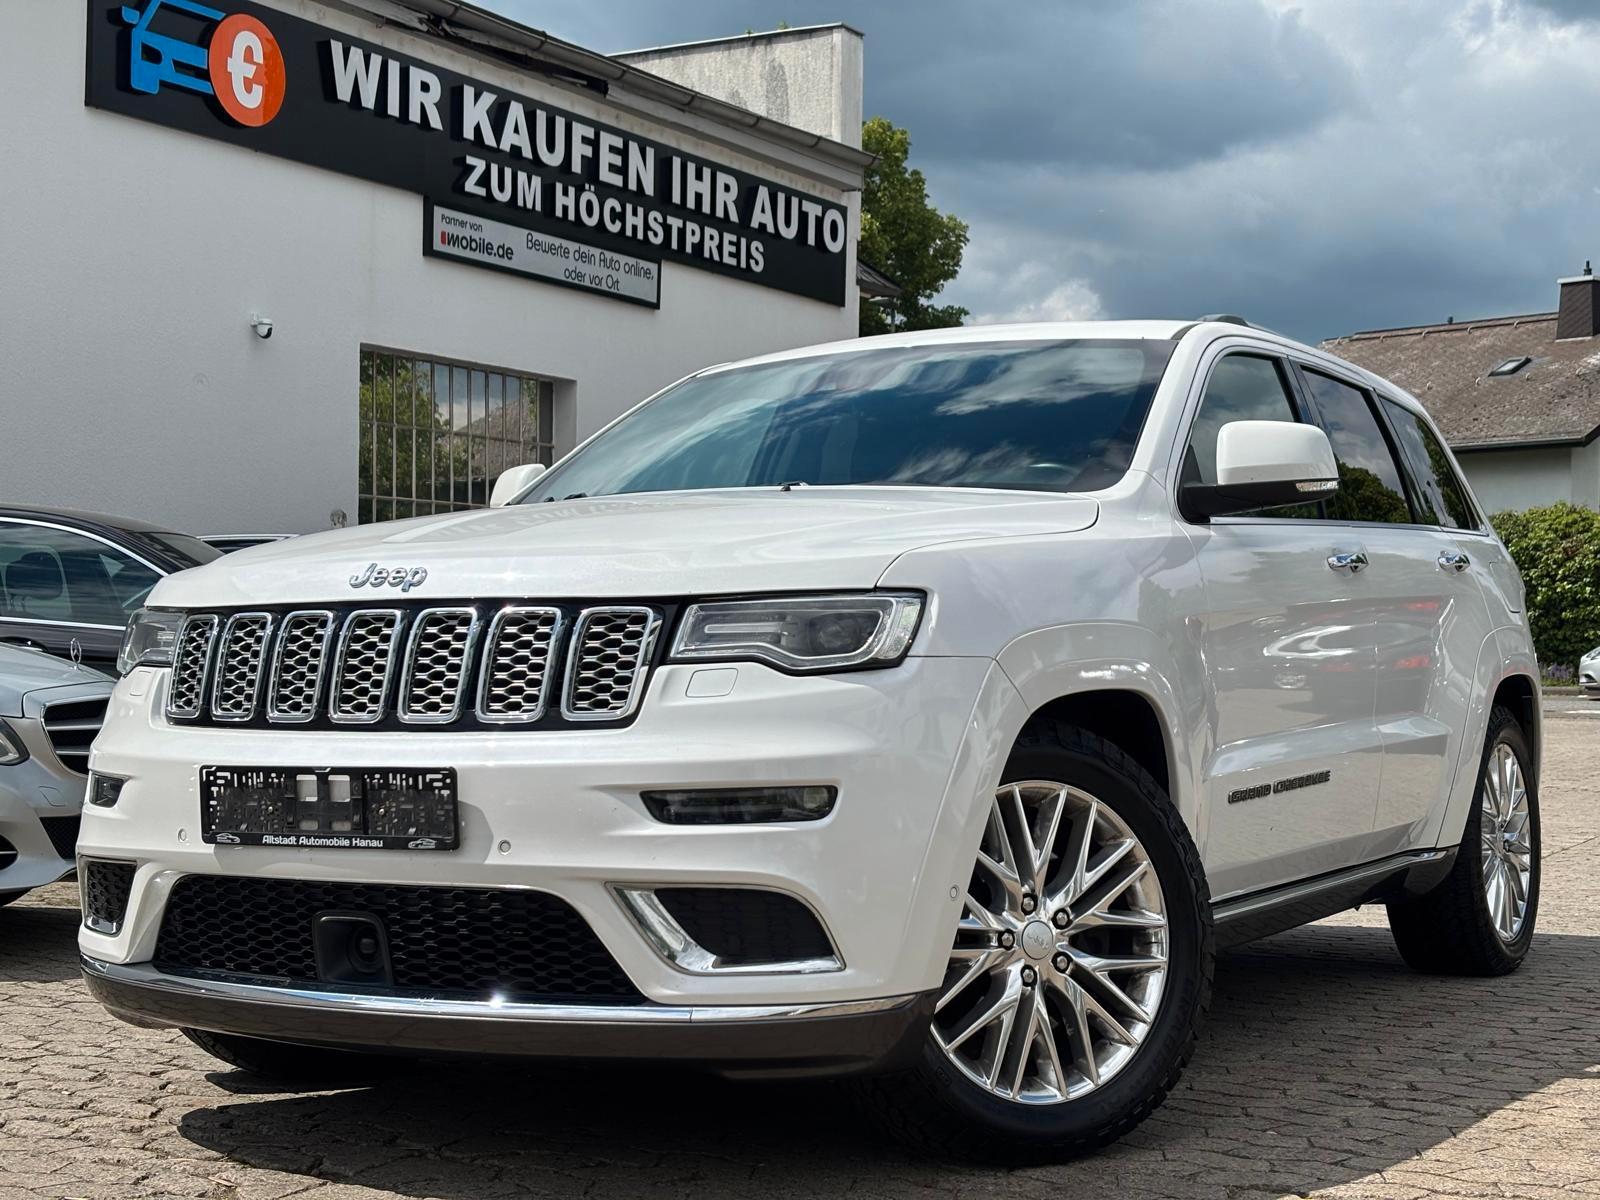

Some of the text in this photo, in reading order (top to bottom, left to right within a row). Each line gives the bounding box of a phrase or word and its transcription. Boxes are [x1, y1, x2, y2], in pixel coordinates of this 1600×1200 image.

[329, 38, 846, 254] WIR KAUFEN IHR AUTO
[441, 213, 483, 233] Partner von
[464, 154, 765, 273] ZUM HÖCHSTPREIS
[446, 231, 514, 261] mobile.de
[526, 232, 655, 281] Bewerte dein Auto online,
[563, 266, 620, 291] oder vor Ort
[349, 562, 428, 593] Jeep
[1227, 769, 1332, 805] GRAND CHEROKEE
[262, 834, 384, 848] Altstadt Automobile Hanau
